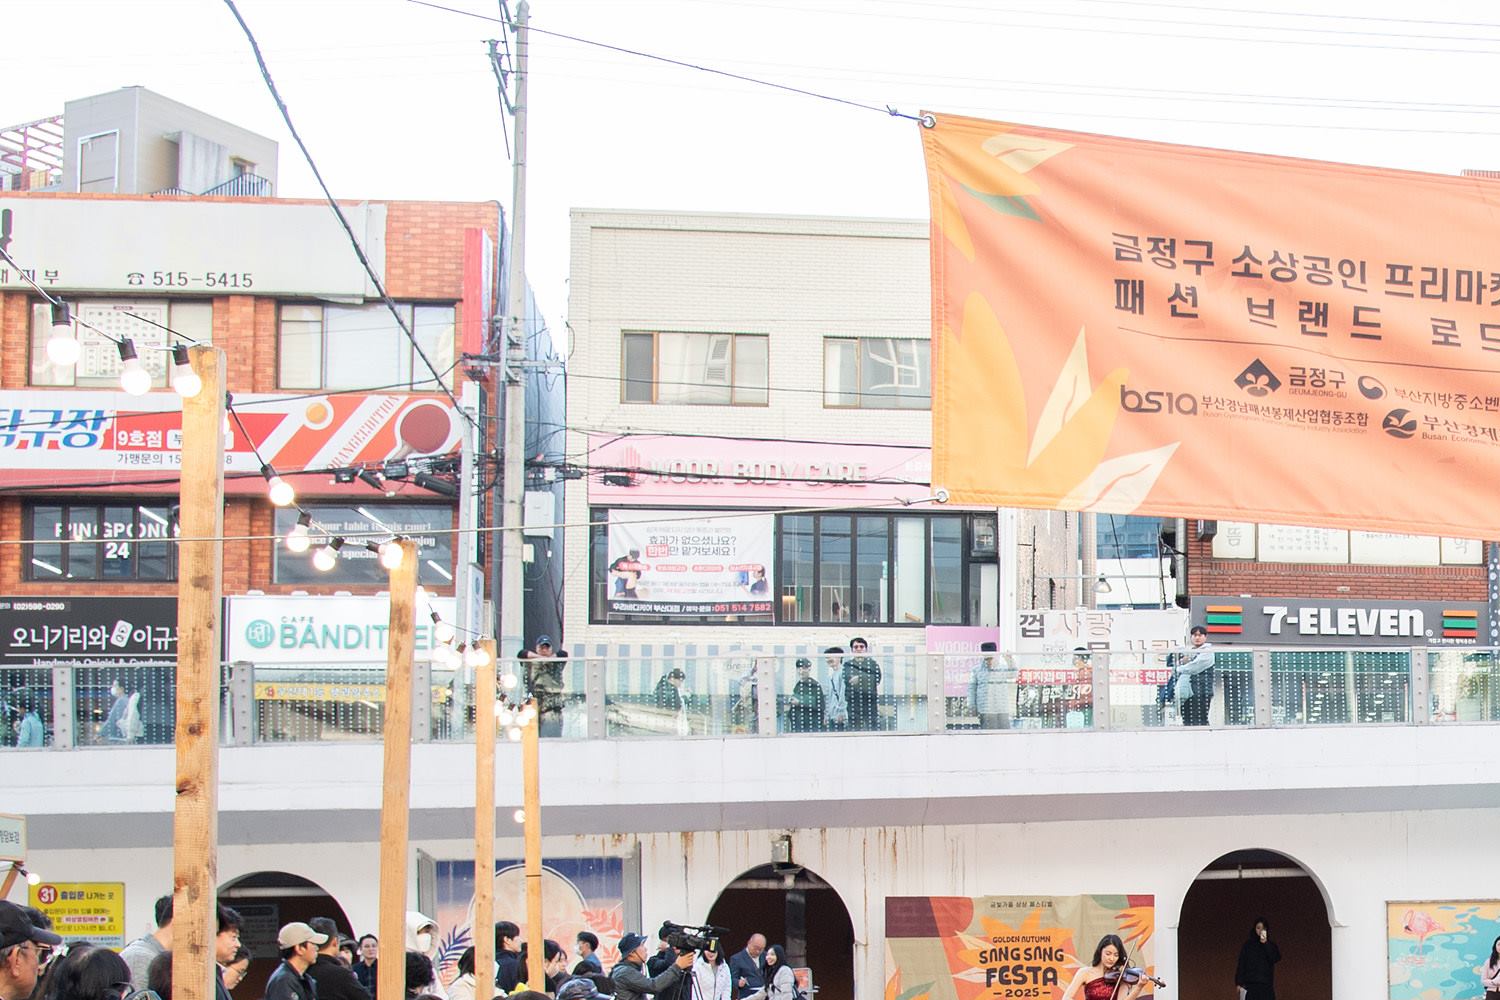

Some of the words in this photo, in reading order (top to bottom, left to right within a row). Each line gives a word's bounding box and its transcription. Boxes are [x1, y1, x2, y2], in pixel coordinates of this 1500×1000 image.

[1112, 232, 1215, 276] 금정구
[1231, 245, 1368, 293] 소상공인
[152, 271, 254, 288] 515-5415
[1289, 366, 1346, 389] 금정구
[1289, 388, 1348, 399] GEUMJEONG-GU
[117, 430, 163, 447] 9호점
[1422, 432, 1448, 442] Busan
[117, 453, 164, 465] 가맹문의
[105, 542, 130, 559] 24
[281, 616, 315, 624] CAFE
[1263, 606, 1425, 637] 7-ELEVEN
[10, 626, 109, 651] 오니기리와
[133, 625, 178, 651] 이규
[40, 888, 55, 902] 31
[1021, 935, 1051, 943] AUTUMN
[979, 946, 1020, 964] SANG
[1023, 946, 1064, 962] SANG
[986, 964, 1058, 988] FESTA
[1005, 988, 1039, 998] 2025
